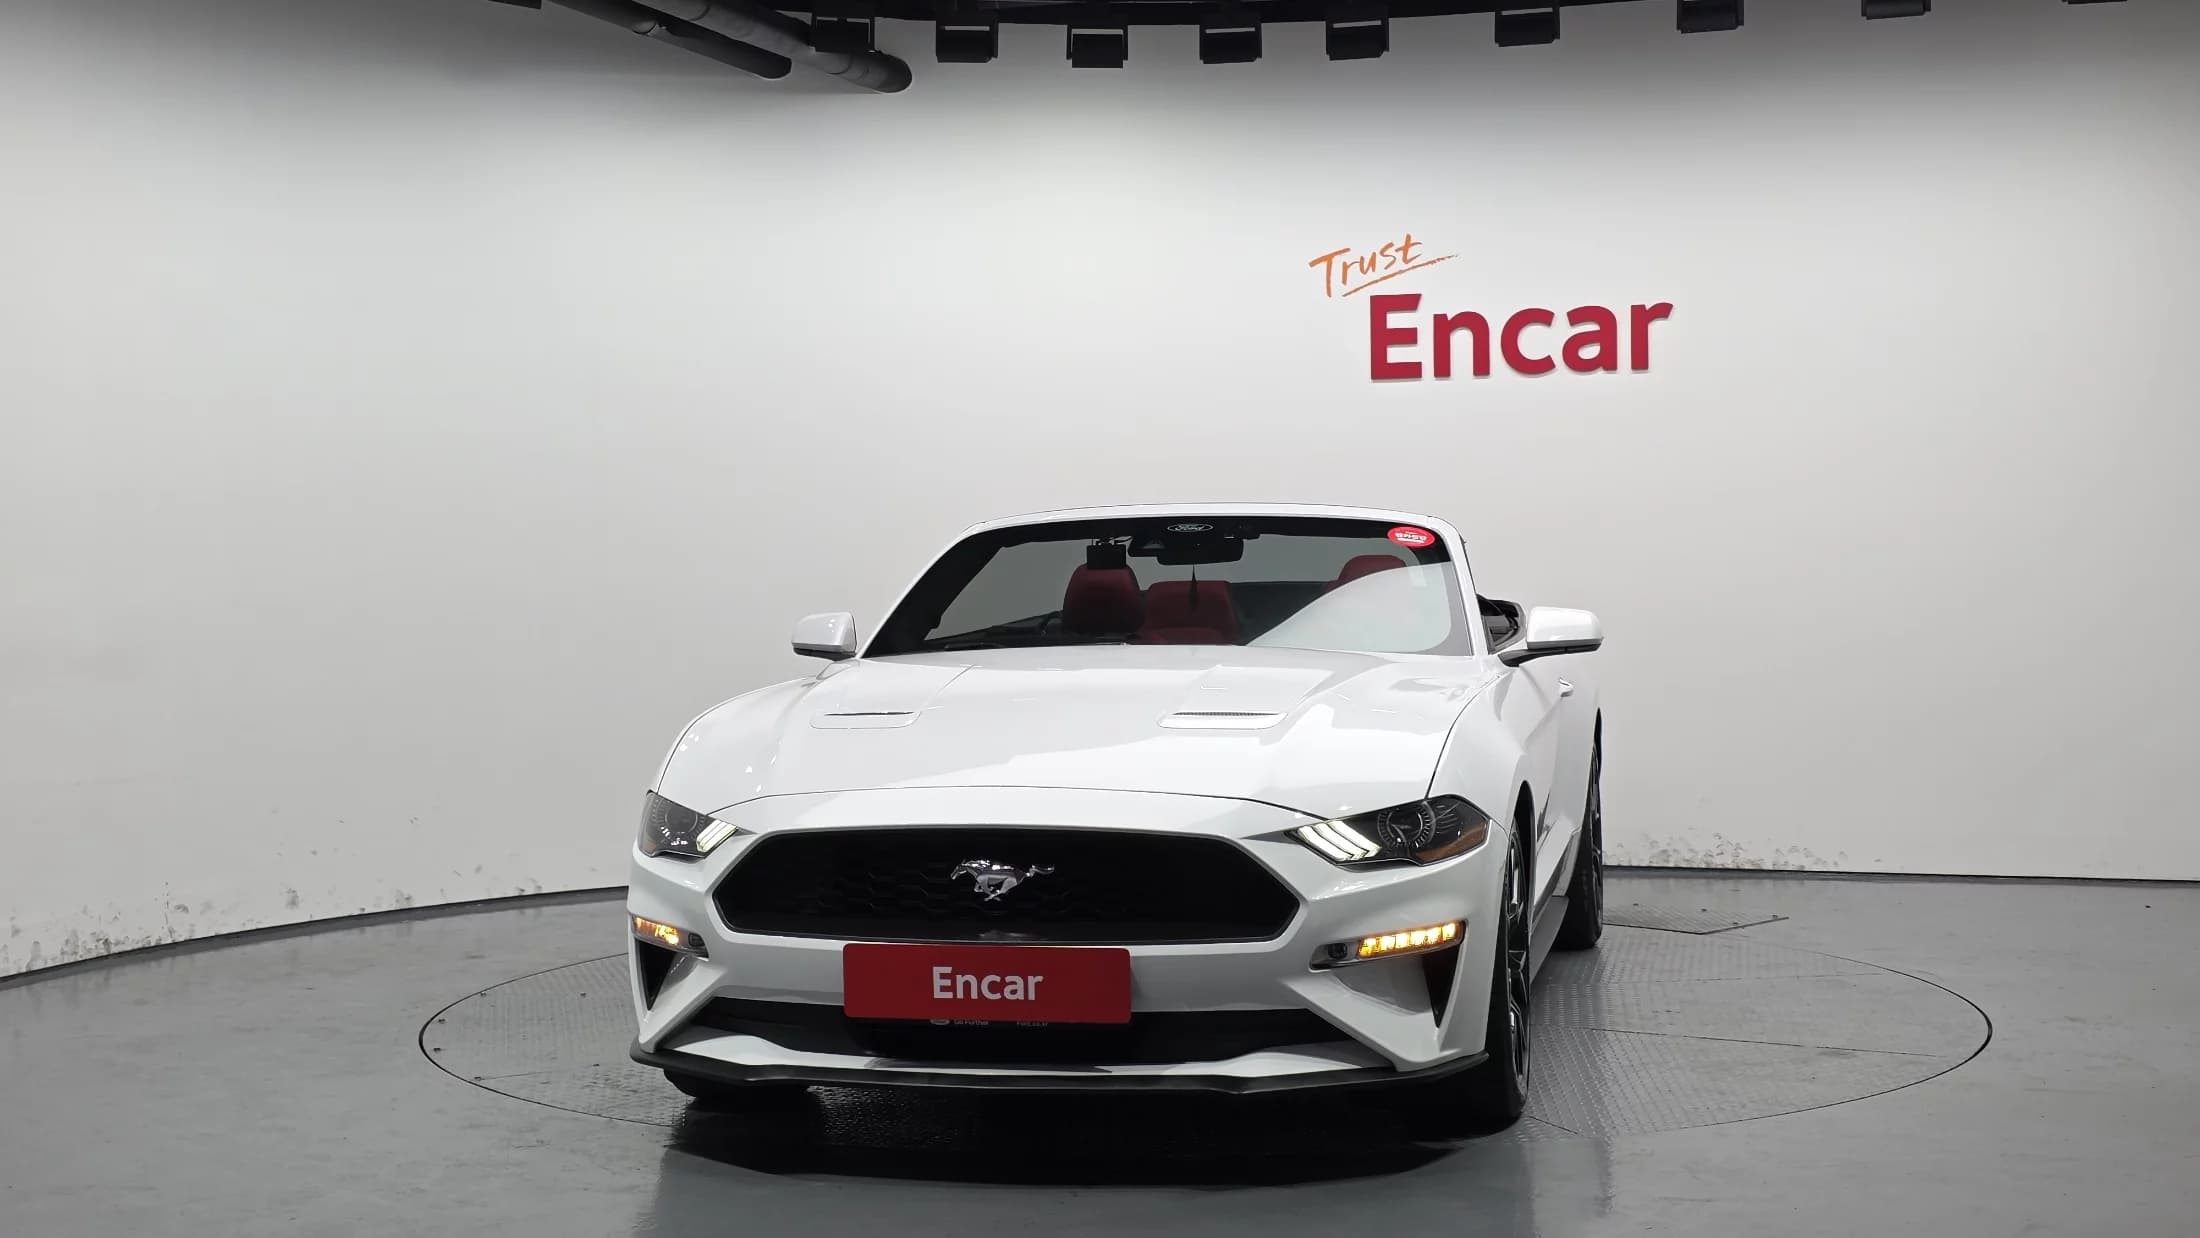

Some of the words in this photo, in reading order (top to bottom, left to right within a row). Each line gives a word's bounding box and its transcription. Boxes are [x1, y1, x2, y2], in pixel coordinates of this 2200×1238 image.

[1309, 233, 1423, 298] Trust
[1370, 293, 1674, 380] Encar
[932, 966, 1044, 1001] Encar
